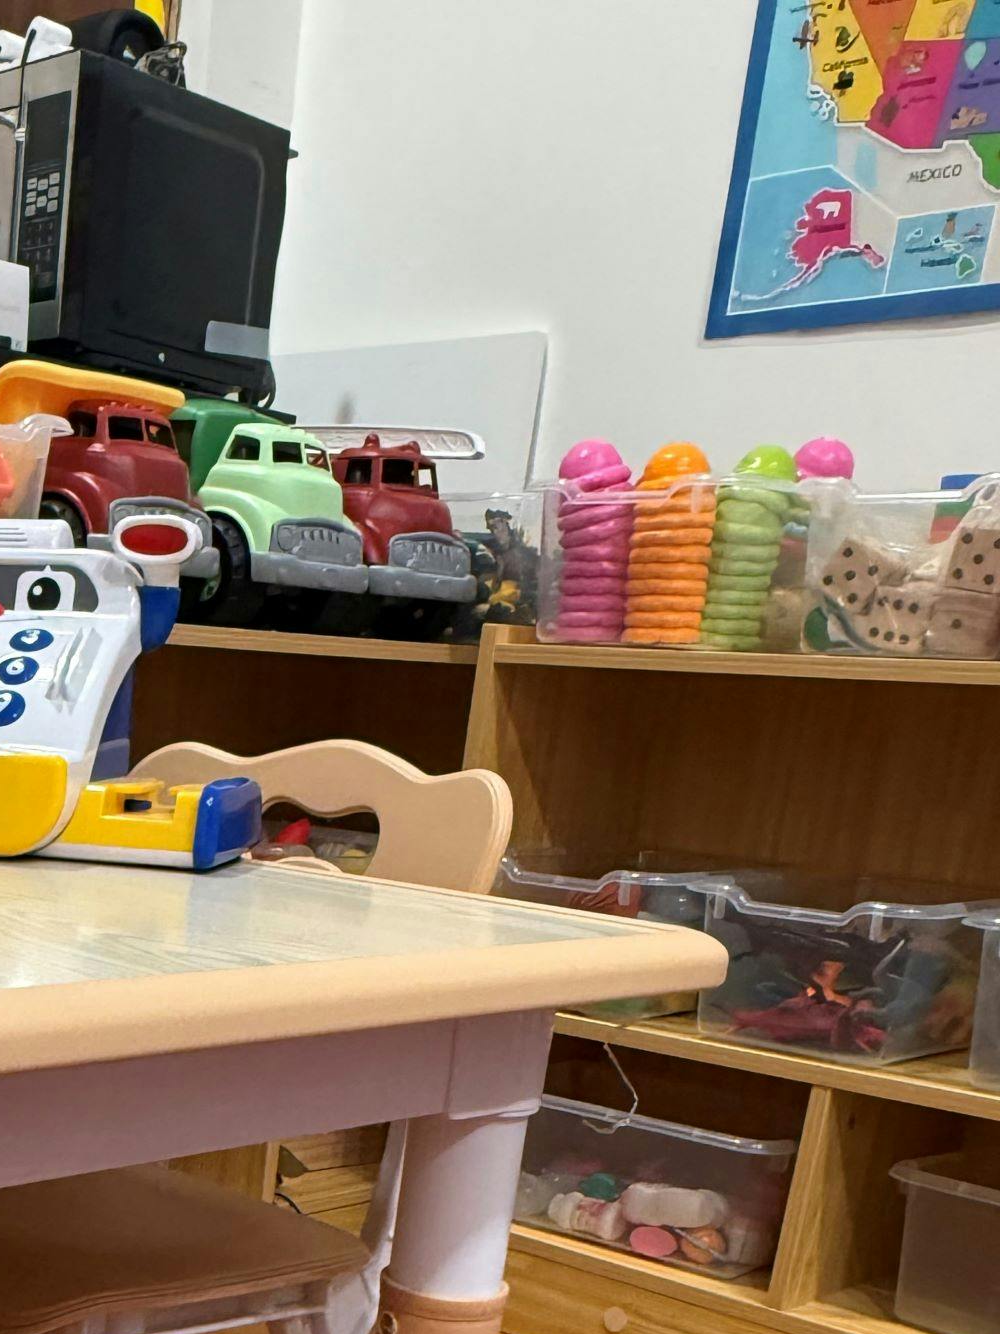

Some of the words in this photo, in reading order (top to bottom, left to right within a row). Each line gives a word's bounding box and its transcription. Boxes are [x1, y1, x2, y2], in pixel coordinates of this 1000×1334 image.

[906, 163, 963, 183] MEXICO
[19, 629, 41, 646] 3
[5, 656, 26, 675] 6
